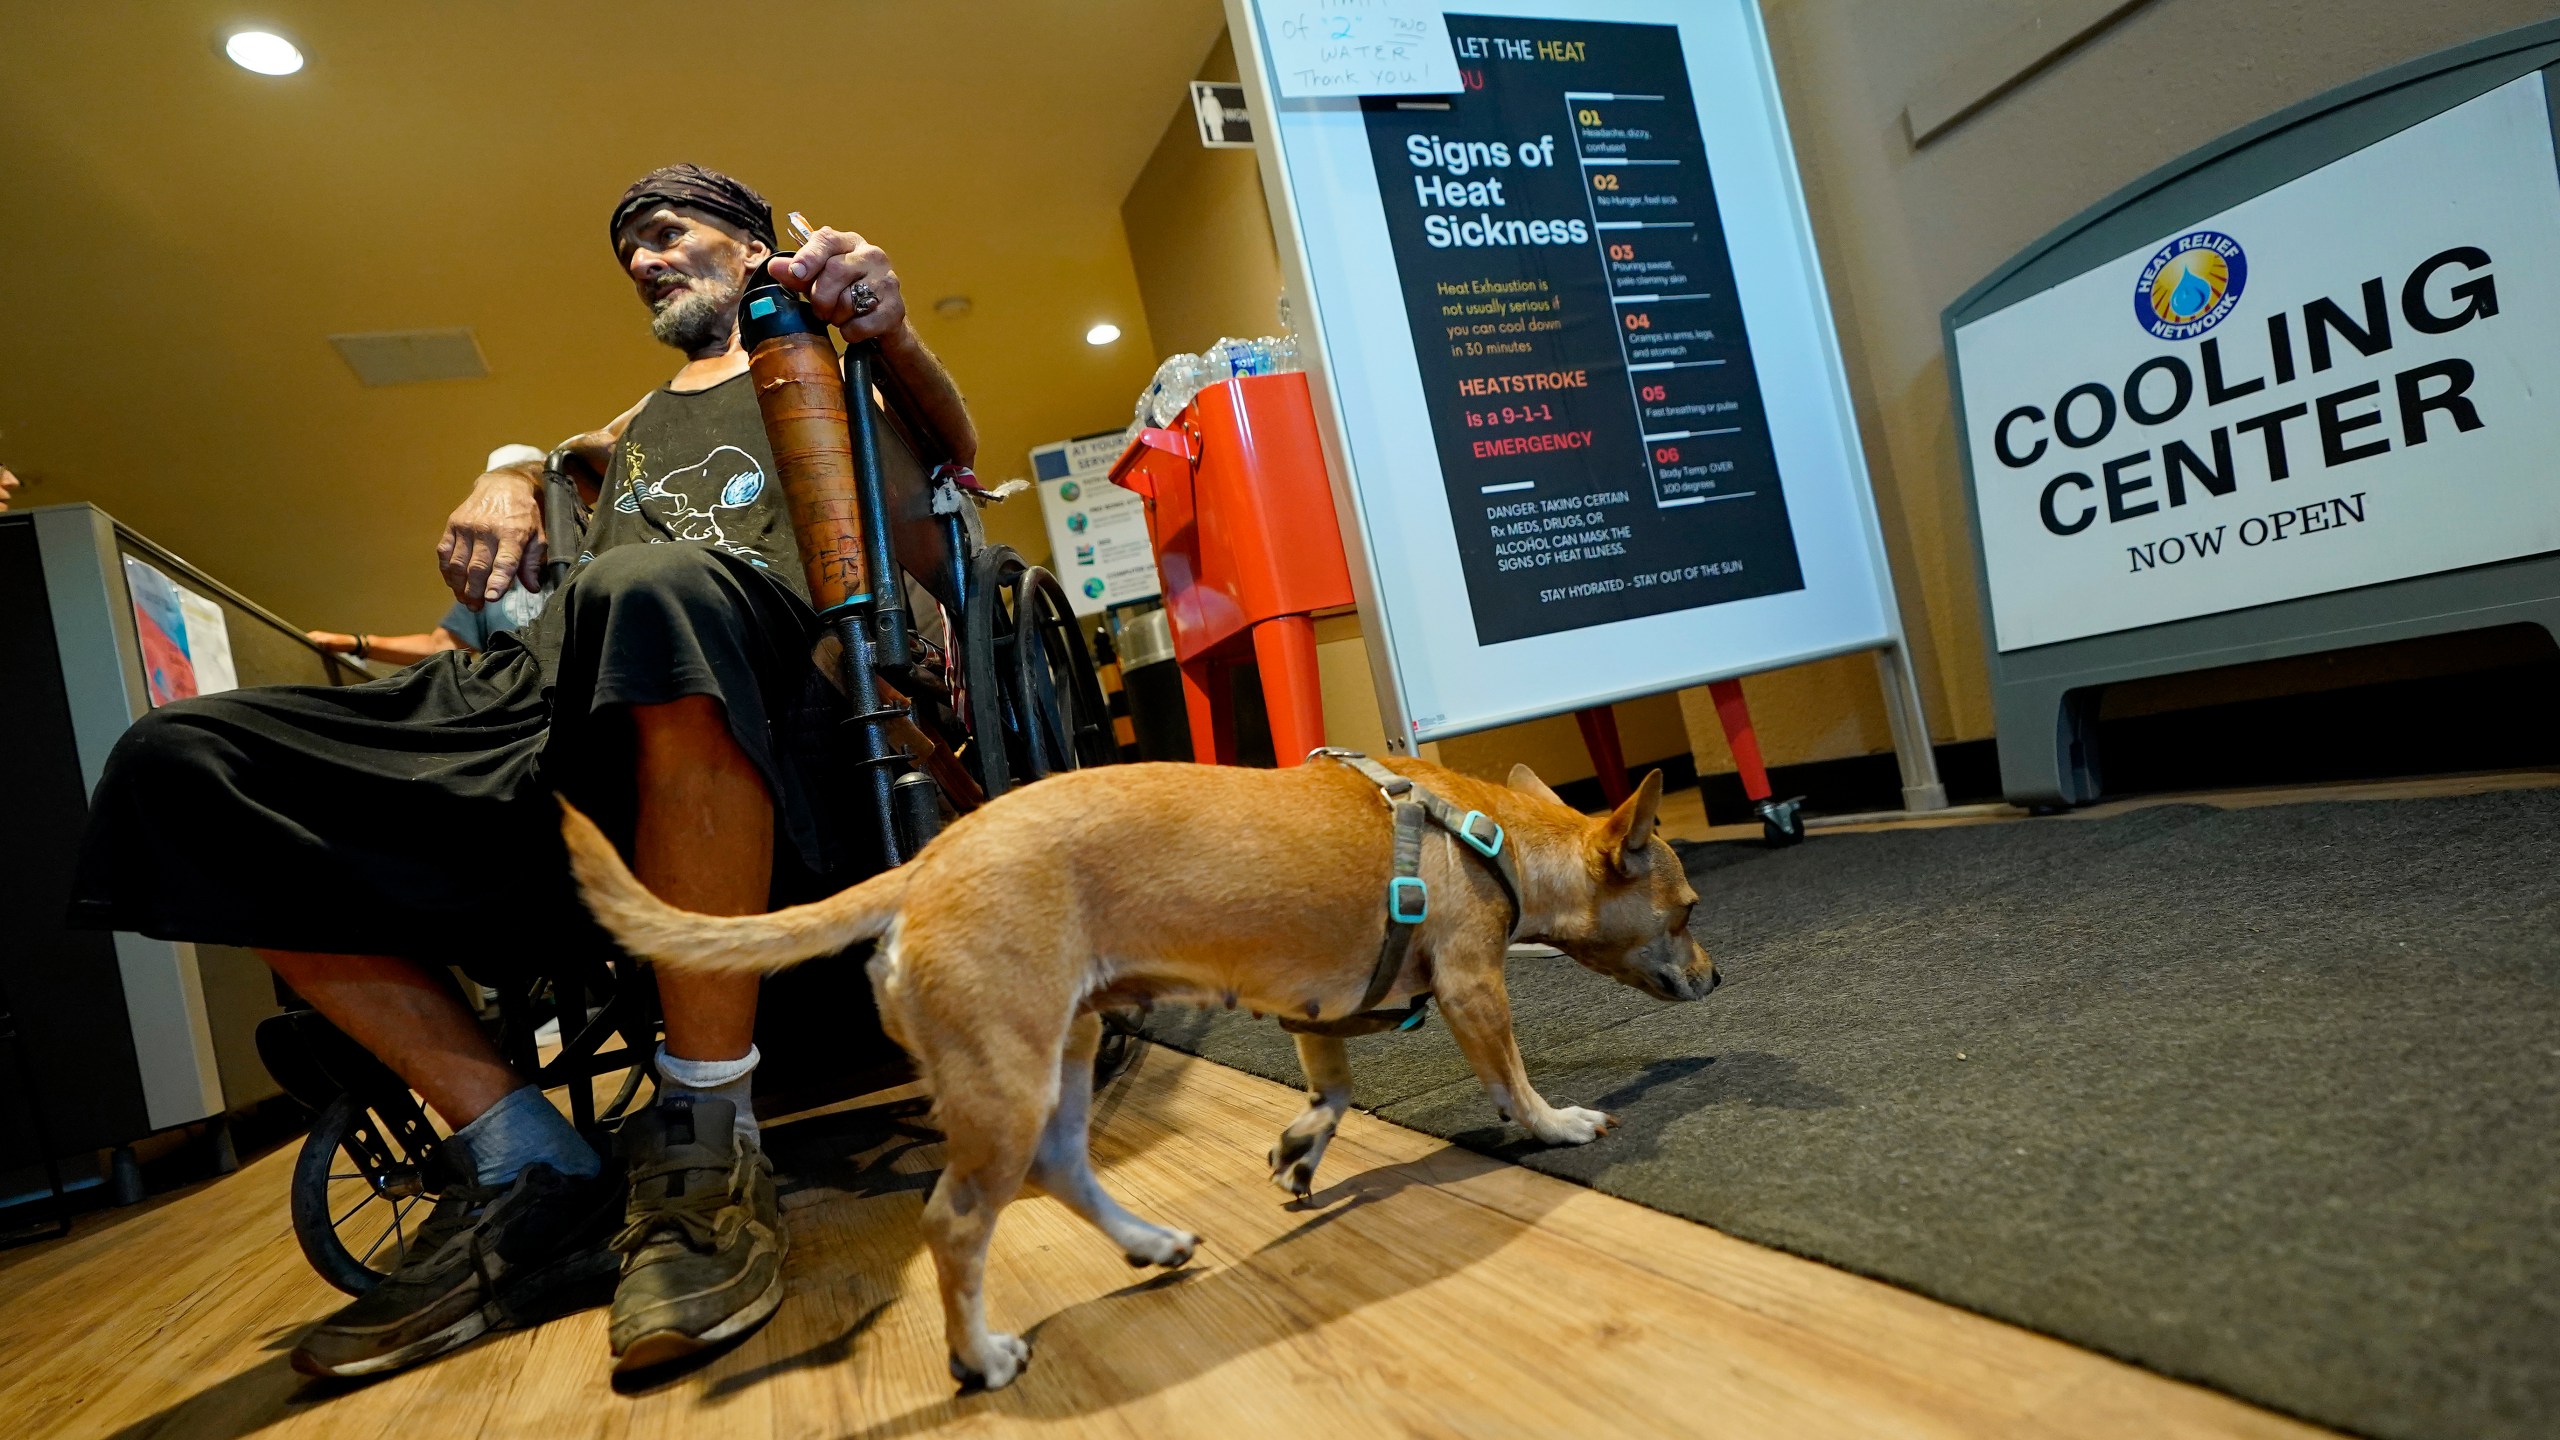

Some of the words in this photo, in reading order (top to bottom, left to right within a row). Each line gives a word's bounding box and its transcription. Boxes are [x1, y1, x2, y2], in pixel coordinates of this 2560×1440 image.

[1321, 46, 1410, 62] WATER
[1457, 36, 1489, 59] LET
[1493, 38, 1534, 60] THE
[1537, 40, 1586, 62] HEAT
[1293, 68, 1359, 88] Thank
[1578, 109, 1602, 127] 01
[1406, 134, 1511, 176] Signs
[1518, 134, 1554, 167] of
[1585, 143, 1626, 153] confused
[1414, 175, 1506, 208] Heat
[1593, 174, 1619, 191] 02
[1597, 196, 1610, 206] No
[1424, 213, 1589, 248] Sickness
[1610, 244, 1635, 261] 03
[2138, 246, 2173, 293] HEAT
[2178, 233, 2239, 258] RELIEF
[1612, 261, 1646, 273] Pouring
[1436, 281, 1470, 296] Heat
[1471, 278, 1537, 295] Exhaustion
[1538, 278, 1549, 292] is
[1616, 276, 1635, 288] pale
[1636, 275, 1669, 287] clammy
[1670, 274, 1687, 284] skin
[1442, 302, 1463, 317] not
[1466, 297, 1506, 317] usually
[1509, 299, 1550, 313] serious
[1552, 294, 1561, 310] if
[2150, 292, 2238, 339] NETWORK
[1446, 326, 1469, 341] you
[1472, 323, 1496, 335] can
[1498, 315, 1526, 333] cool
[1528, 315, 1561, 332] down
[1625, 313, 1650, 330] 04
[1451, 344, 1463, 357] in
[1464, 341, 1483, 357] 30
[1486, 340, 1533, 355] minutes
[1629, 332, 1663, 344] Cramps
[1633, 347, 1649, 358] and
[1650, 346, 1687, 357] stomach
[1994, 245, 2500, 468] COOLING
[1458, 370, 1588, 397] HEATSTROKE
[1642, 385, 1666, 401] 05
[1466, 410, 1483, 428] is
[1487, 411, 1499, 426] a
[1501, 404, 1553, 424] 9-1-1
[1645, 407, 1665, 418] Fast
[1666, 404, 1706, 416] breathing
[1472, 430, 1592, 459] EMERGENCY
[2039, 357, 2486, 537] CENTER
[1656, 447, 1680, 464] 06
[1660, 467, 1682, 480] Body
[1683, 465, 1707, 476] Temp
[1709, 461, 1734, 472] OVER
[1681, 480, 1716, 492] degrees
[1486, 501, 1539, 520] DANGER:
[1540, 496, 1583, 513] TAKING
[1583, 490, 1630, 508] CERTAIN
[1490, 525, 1506, 538] Rx
[1507, 519, 1543, 537] MEDS,
[1543, 514, 1586, 532] DRUGS,
[1586, 511, 1605, 525] OR
[2127, 526, 2227, 573] NOW
[2238, 492, 2367, 547] OPEN
[1495, 536, 1552, 556] ALCOHOL
[1552, 534, 1578, 548] CAN
[1579, 529, 1611, 544] MASK
[1611, 525, 1632, 539] THE
[1498, 555, 1534, 572] SIGNS
[1535, 553, 1552, 566] OF
[1554, 549, 1585, 564] HEAT
[1584, 542, 1627, 560] ILLNESS.
[1540, 588, 1569, 603] STAY
[1568, 578, 1625, 598] HYDRATED
[1633, 574, 1660, 589] STAY
[1659, 569, 1682, 584] OUT
[1684, 566, 1700, 580] OF
[1700, 563, 1720, 578] THE
[1720, 560, 1744, 574] SUN
